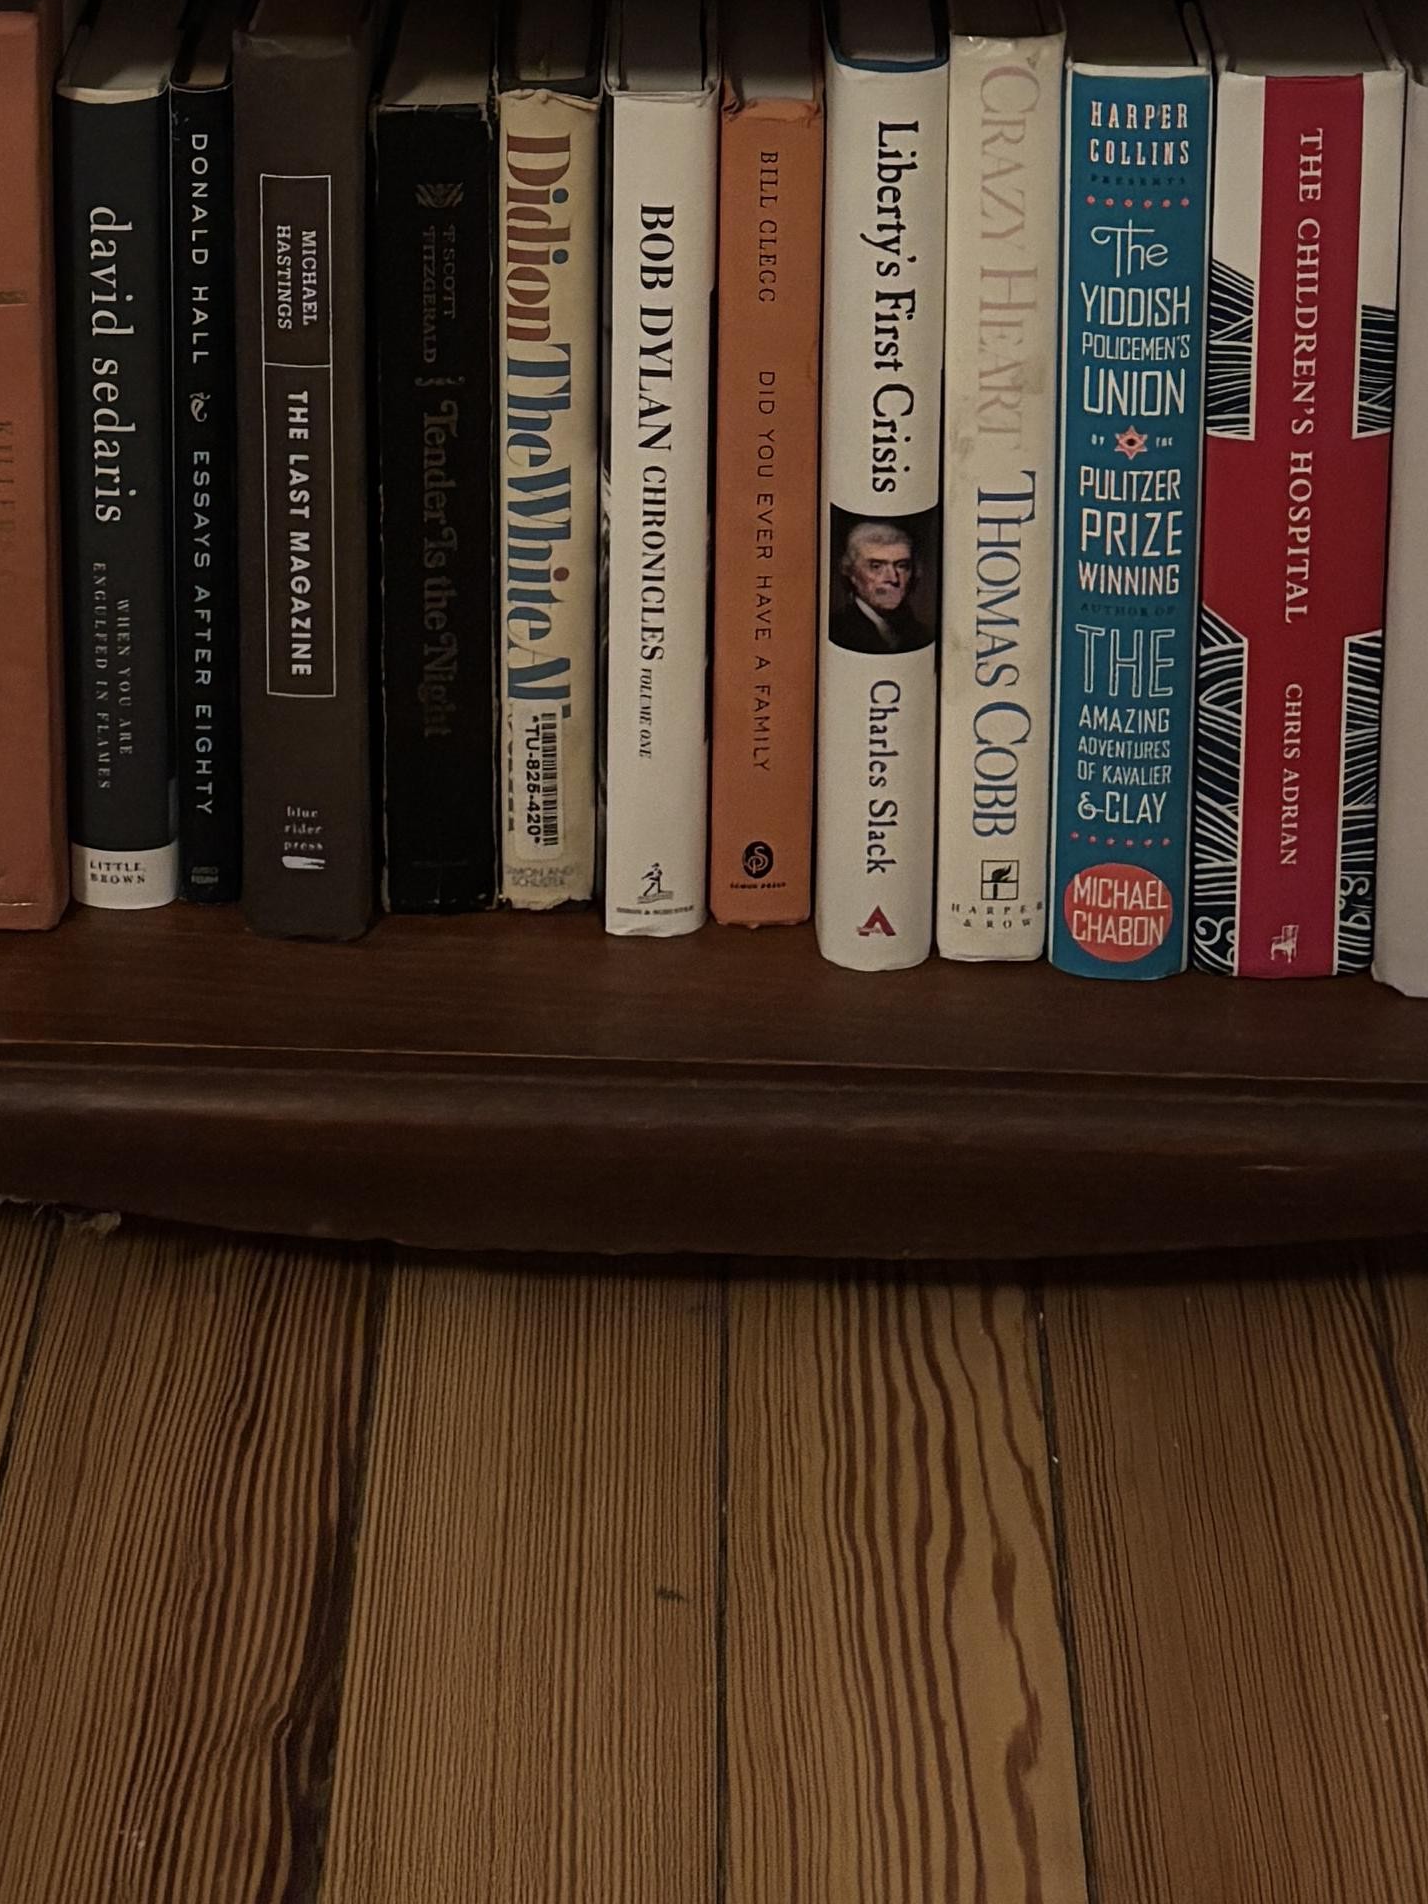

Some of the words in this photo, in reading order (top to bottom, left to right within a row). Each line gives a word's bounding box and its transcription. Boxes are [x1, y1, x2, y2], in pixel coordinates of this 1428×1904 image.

[1090, 101, 1188, 130] HARPER
[1090, 138, 1189, 166] COLLINS
[190, 133, 209, 265] DONALD
[860, 120, 919, 277] Liberty's
[1298, 128, 1324, 202] THE
[89, 206, 134, 337] david
[639, 204, 675, 291] BOB
[191, 286, 210, 364] HALL
[872, 289, 917, 371] First
[1080, 282, 1190, 327] YIDDISH
[1291, 217, 1322, 436] CHILDREN'S
[638, 304, 674, 451] DYLAN
[1083, 366, 1185, 416] UNION
[91, 356, 136, 523] sedaris
[872, 383, 915, 493] Crisis
[1284, 451, 1314, 623] HOSPITAL
[1072, 873, 1168, 911] MICHAEL
[1072, 909, 1164, 947] CHABON
